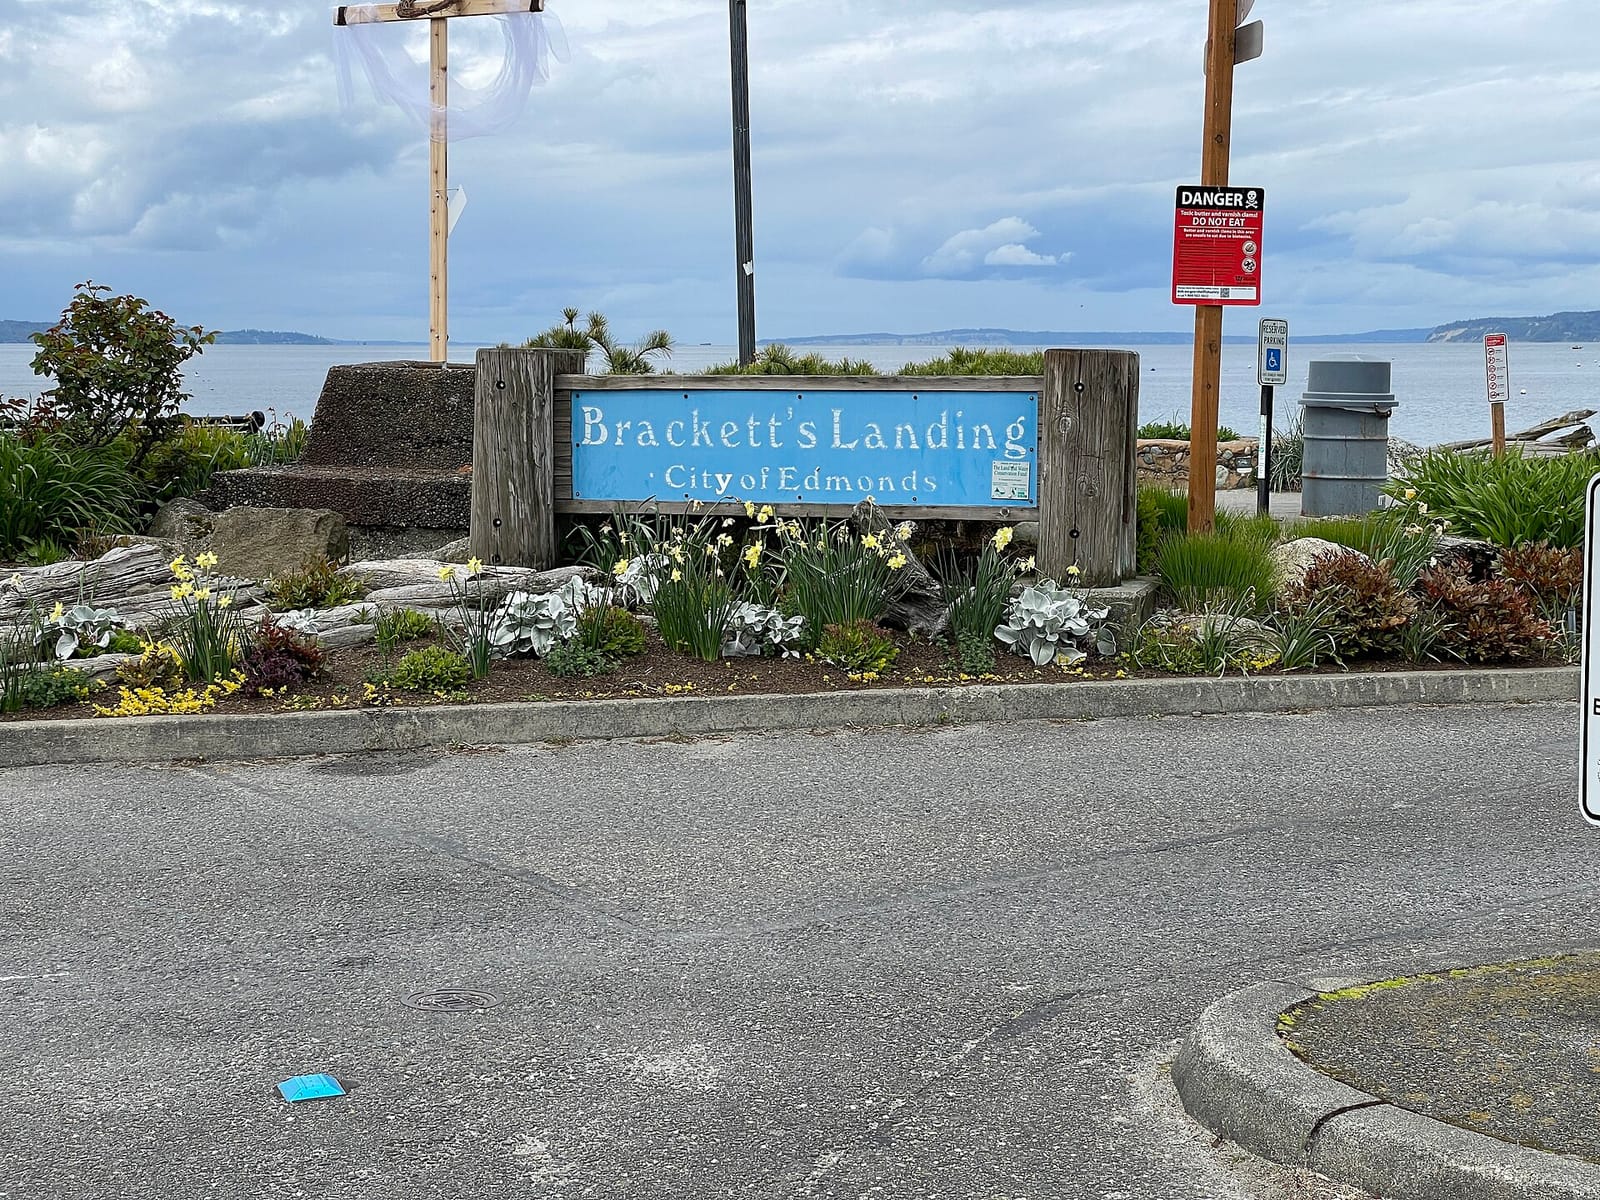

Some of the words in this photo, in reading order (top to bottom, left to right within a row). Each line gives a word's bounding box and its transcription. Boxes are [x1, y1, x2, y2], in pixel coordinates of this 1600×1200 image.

[1181, 191, 1243, 207] DANGER
[1192, 217, 1206, 226] DO
[1208, 217, 1227, 226] NOT
[1229, 218, 1245, 227] EAT
[1263, 324, 1286, 334] RESERVED
[1263, 336, 1284, 345] PARKING
[582, 406, 817, 449] Brackett's
[831, 408, 1026, 459] Landing
[665, 464, 733, 494] City
[740, 466, 770, 490] of
[777, 466, 937, 492] Edmonds
